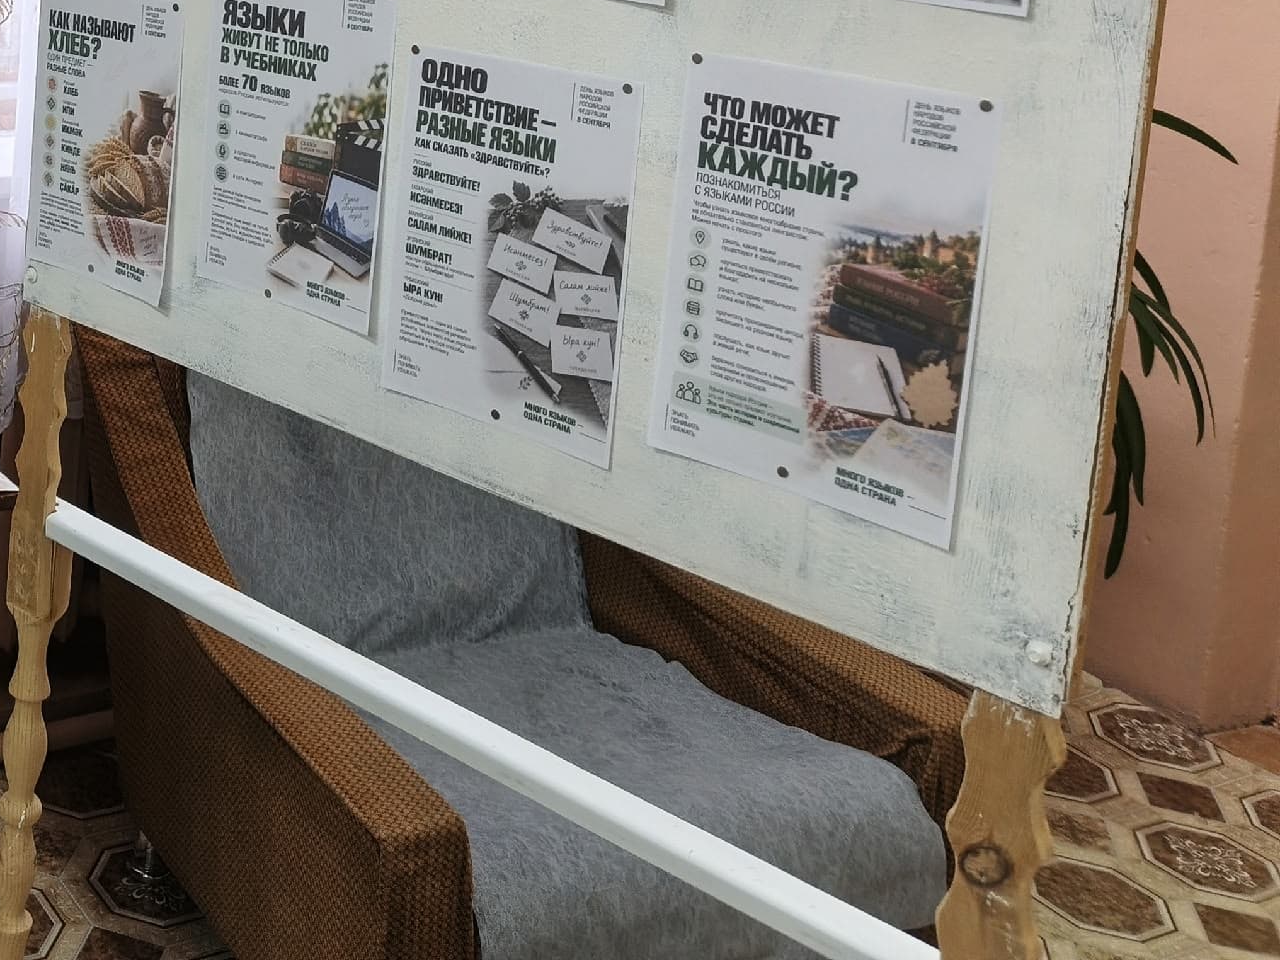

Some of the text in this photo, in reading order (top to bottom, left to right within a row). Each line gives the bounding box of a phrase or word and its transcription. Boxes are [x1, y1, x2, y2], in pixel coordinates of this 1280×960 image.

[49, 9, 136, 43] КАК НАЗЫВАЮТ
[48, 29, 102, 60] ХЛЕБ?
[221, 27, 329, 62] ЖИВУТ НЕ ТОЛЬКО
[46, 63, 86, 78] РАЗНЫЕ СЛОВА
[220, 46, 317, 81] В УЧЕБНИКАХ
[421, 58, 488, 93] ОДНО
[63, 85, 79, 97] ХЛЕБ
[219, 74, 291, 99] БОЛЕЕ 70 ЯЗЫКОВ
[419, 86, 540, 132] ПРИВЕТСТВИЕ
[704, 91, 840, 139] ЧТО МОЖЕТ
[416, 109, 557, 164] РАЗНЫЕ ЯЗЫКИ
[699, 115, 813, 160] СДЕЛАТЬ
[414, 136, 551, 179] КАК СКАЗАТЬ «ЗДРАВСТВУЙТЕ»?
[697, 141, 859, 202] КАЖДЫЙ?
[412, 165, 481, 192] ЗДРАВСТВУЙТЕ!
[696, 170, 781, 201] ПОЗНАКОМИТЬСЯ
[694, 184, 796, 217] С ЯЗЫКАМИ РОССИИ
[405, 242, 453, 266] ШУМБРАТ!
[403, 282, 443, 303] ЫРА КУН!
